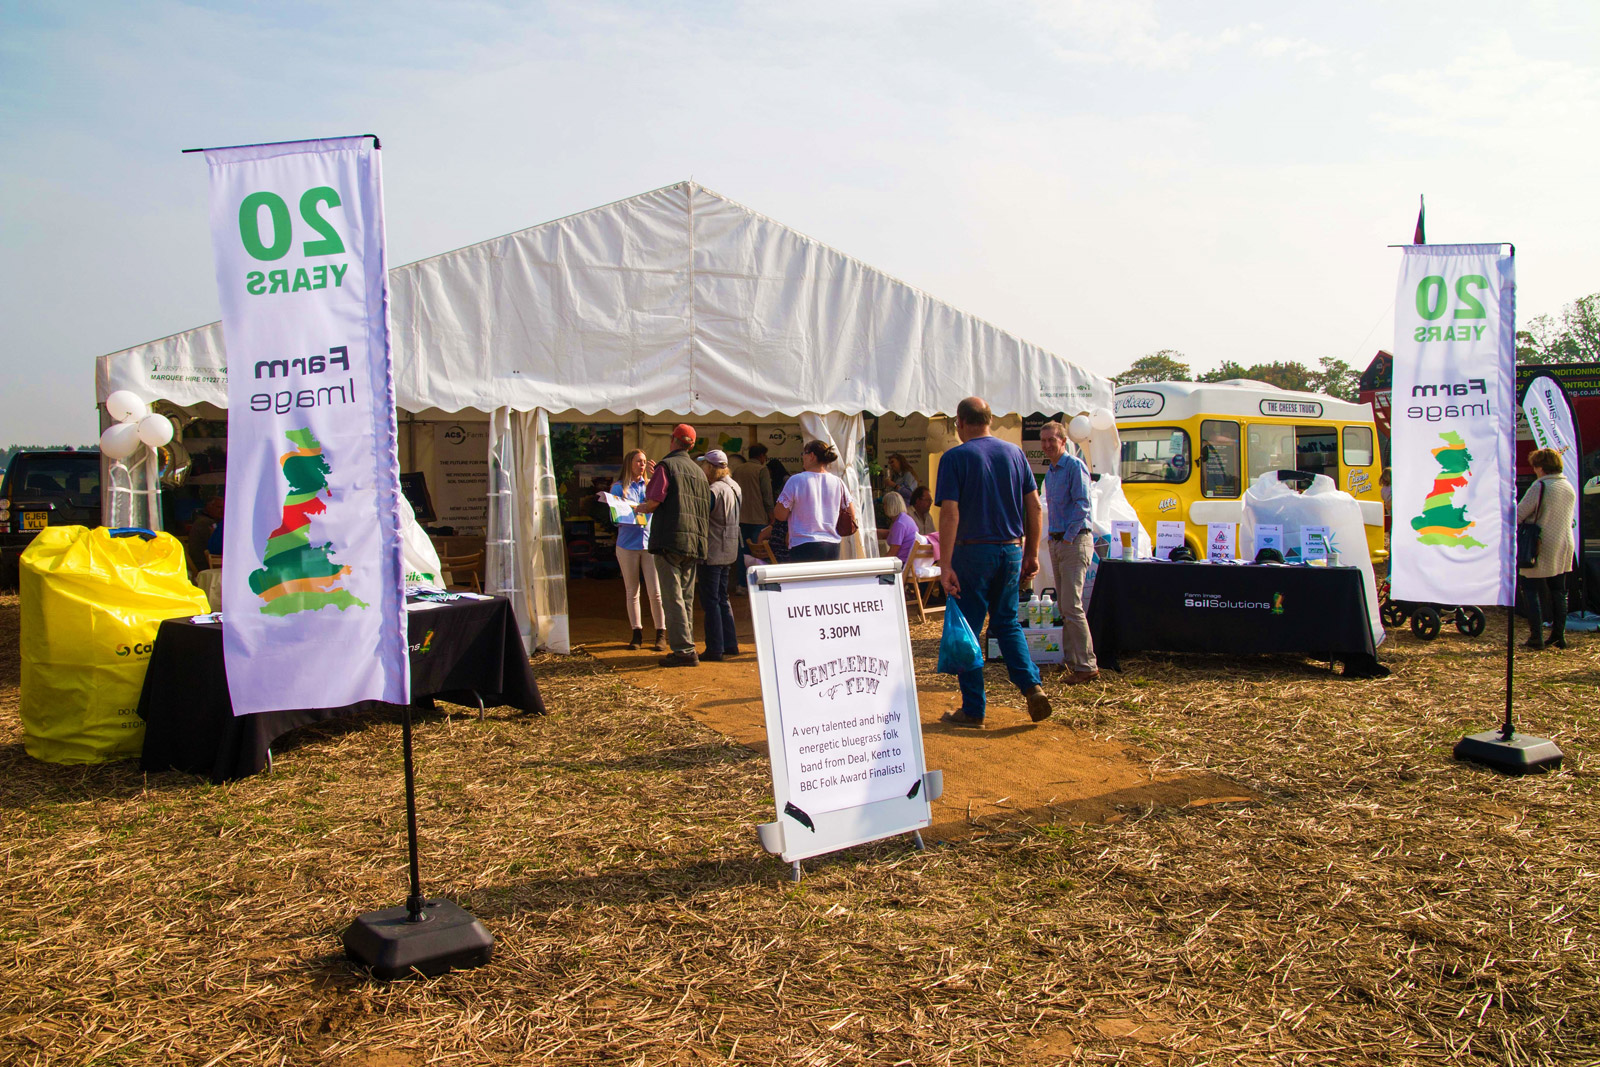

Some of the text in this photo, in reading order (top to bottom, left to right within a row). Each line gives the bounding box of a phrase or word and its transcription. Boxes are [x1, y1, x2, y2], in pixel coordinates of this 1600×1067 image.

[1122, 394, 1155, 409] Cheese
[1268, 402, 1316, 413] THE CHEESE TRUCK
[1530, 407, 1548, 447] SMAR
[1158, 497, 1177, 510] Alfie
[24, 512, 47, 520] GJ66
[27, 520, 44, 528] VLL
[787, 599, 884, 619] LIVE MUSIC HERE!
[1184, 598, 1271, 609] SoilSolutions
[819, 624, 861, 640] 3.30PM
[793, 654, 890, 688] GENTLEMEN
[845, 676, 880, 696] FEW
[121, 720, 146, 729] STOR
[791, 711, 901, 737] A very talented and highly
[799, 729, 899, 755] energetic bluegrass folk
[800, 747, 902, 773] band from Deal, Kent to
[800, 762, 906, 792] BBC Folk Award Finalists!
